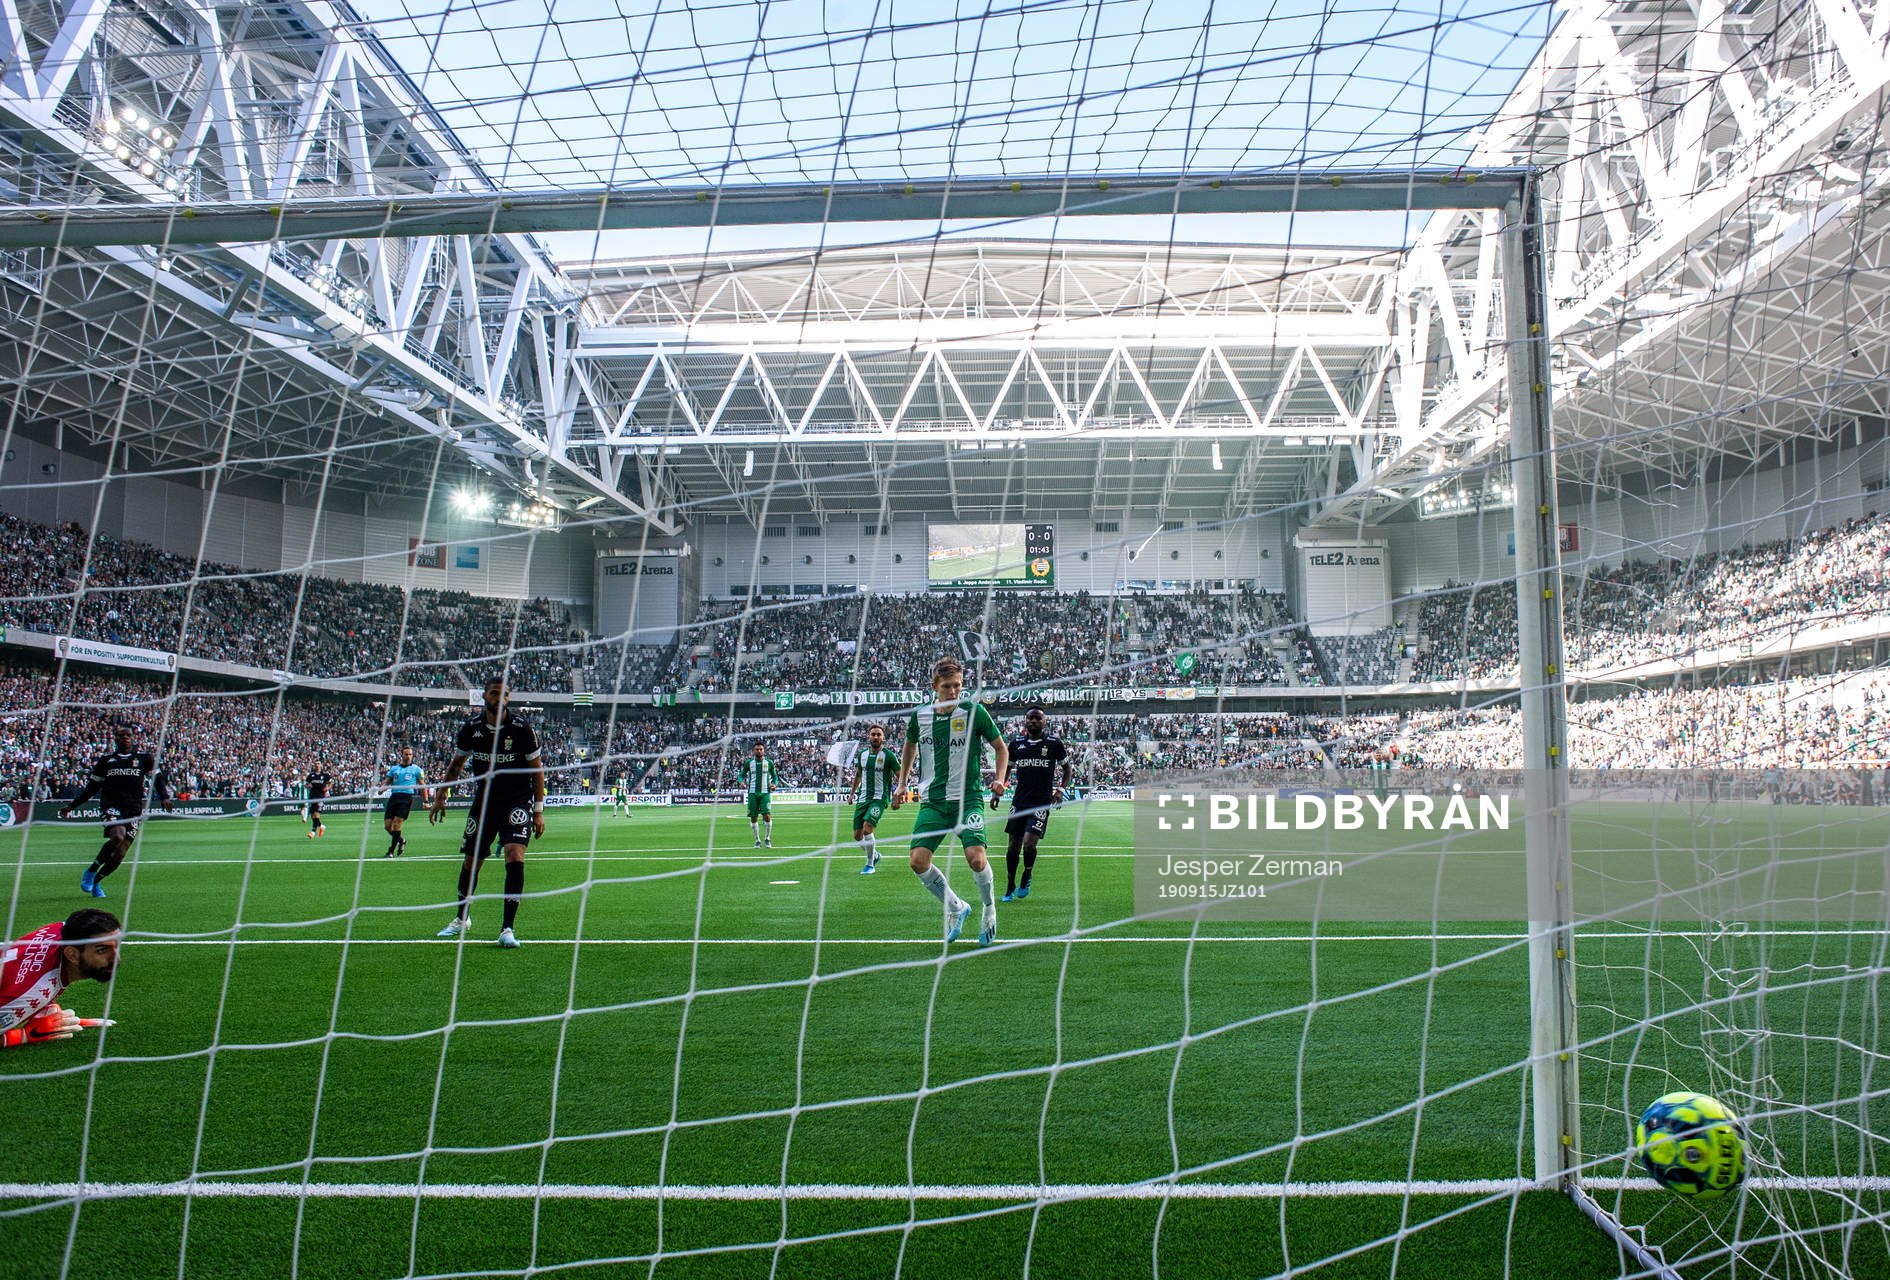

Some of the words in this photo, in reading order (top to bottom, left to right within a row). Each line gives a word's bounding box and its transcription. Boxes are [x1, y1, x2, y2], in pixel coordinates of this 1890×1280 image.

[1028, 532, 1035, 540] 0
[1044, 532, 1050, 540] 0
[1029, 546, 1050, 554] 01:43
[1310, 552, 1344, 566] TELE2
[1347, 556, 1380, 566] Arena
[604, 562, 637, 576] TELE2
[641, 565, 674, 576] Arena
[70, 645, 83, 654] FÖR
[84, 647, 93, 656] EN
[93, 649, 115, 659] POSITIV
[116, 652, 166, 666] SUPPORTERKULTUR
[866, 691, 922, 704] ULTRAS
[999, 688, 1040, 703] BOYS
[473, 752, 517, 763] SEREKE
[545, 797, 574, 805] CRAFT
[610, 796, 667, 804] INERSPORT
[57, 810, 82, 819] SMLA
[521, 827, 528, 835] 5
